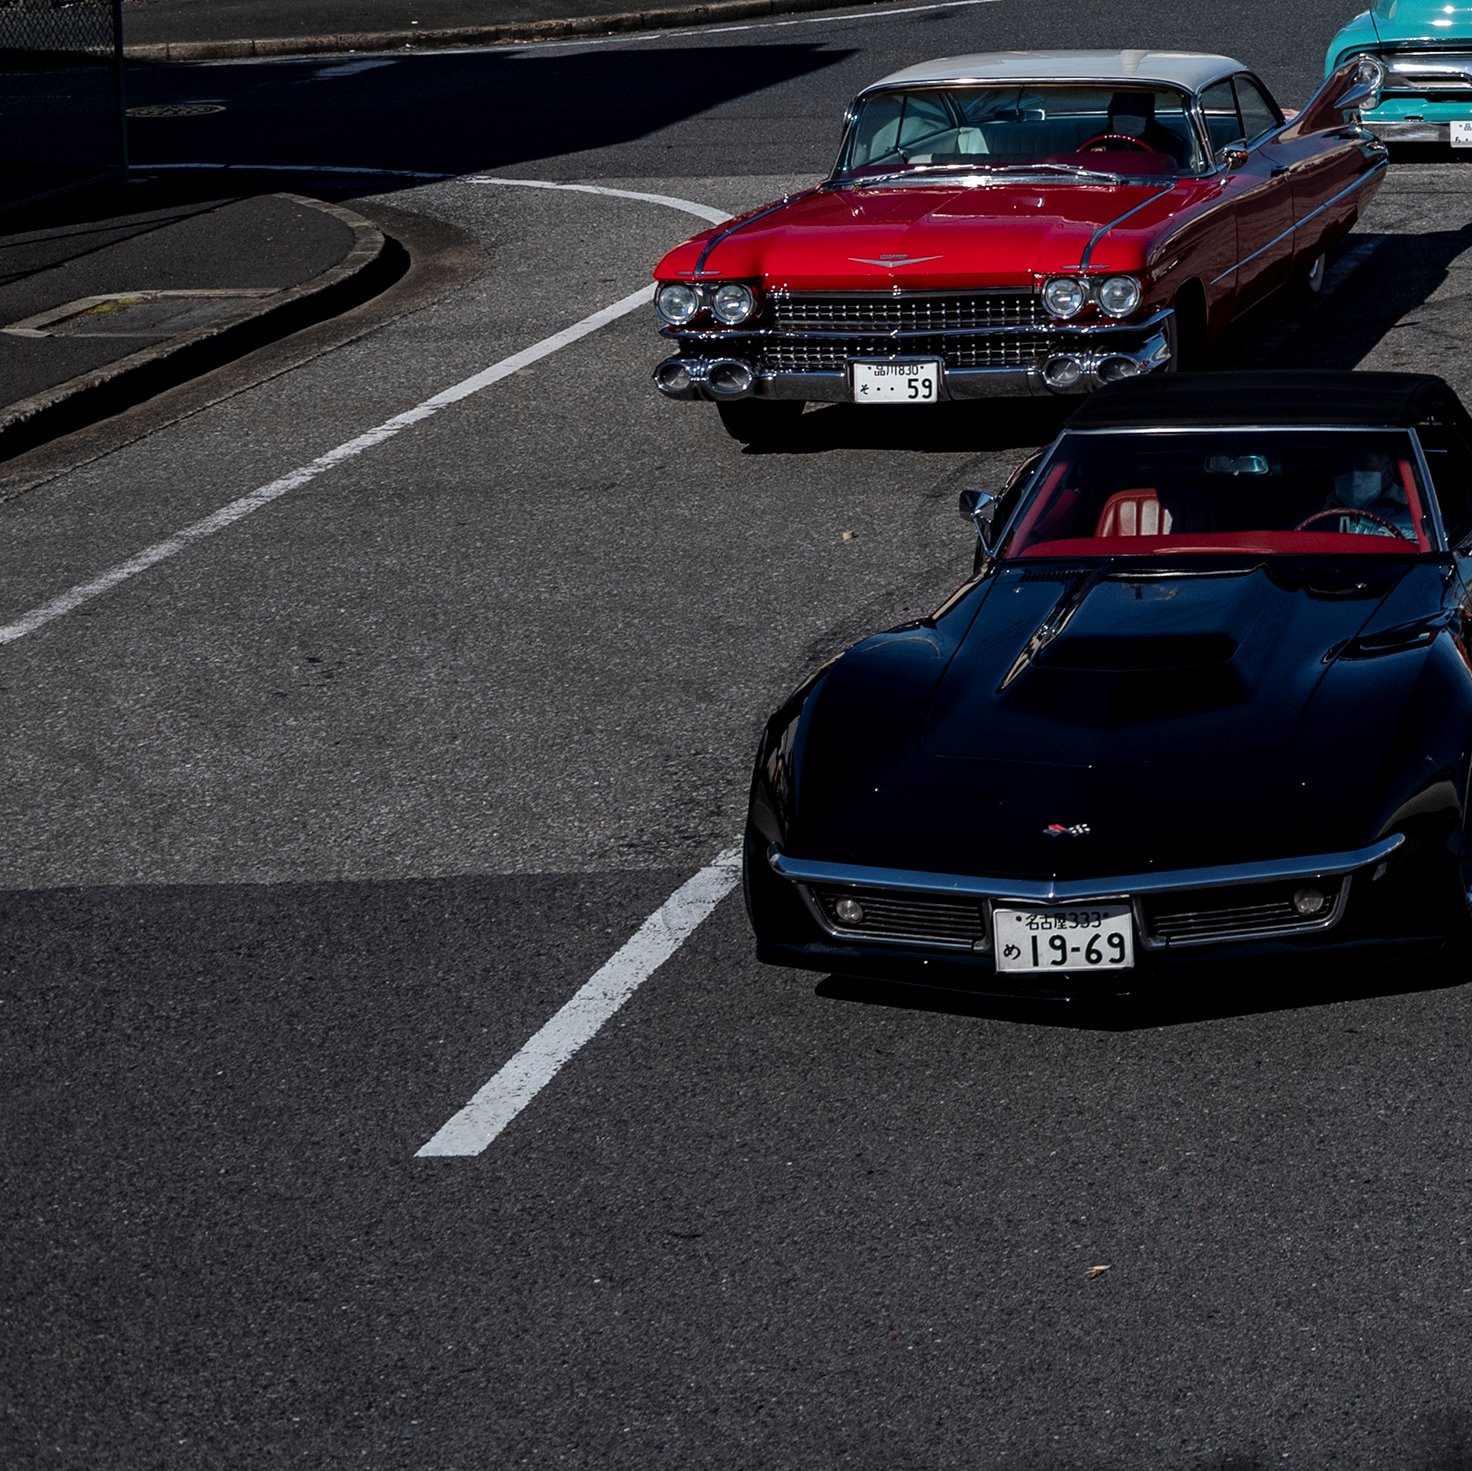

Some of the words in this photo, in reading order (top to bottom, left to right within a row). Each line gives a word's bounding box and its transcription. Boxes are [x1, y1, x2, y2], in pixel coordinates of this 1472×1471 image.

[908, 378, 933, 399] 59
[1025, 911, 1102, 930] 名古屋333
[1003, 943, 1021, 960] め
[1031, 932, 1126, 967] 19-69
